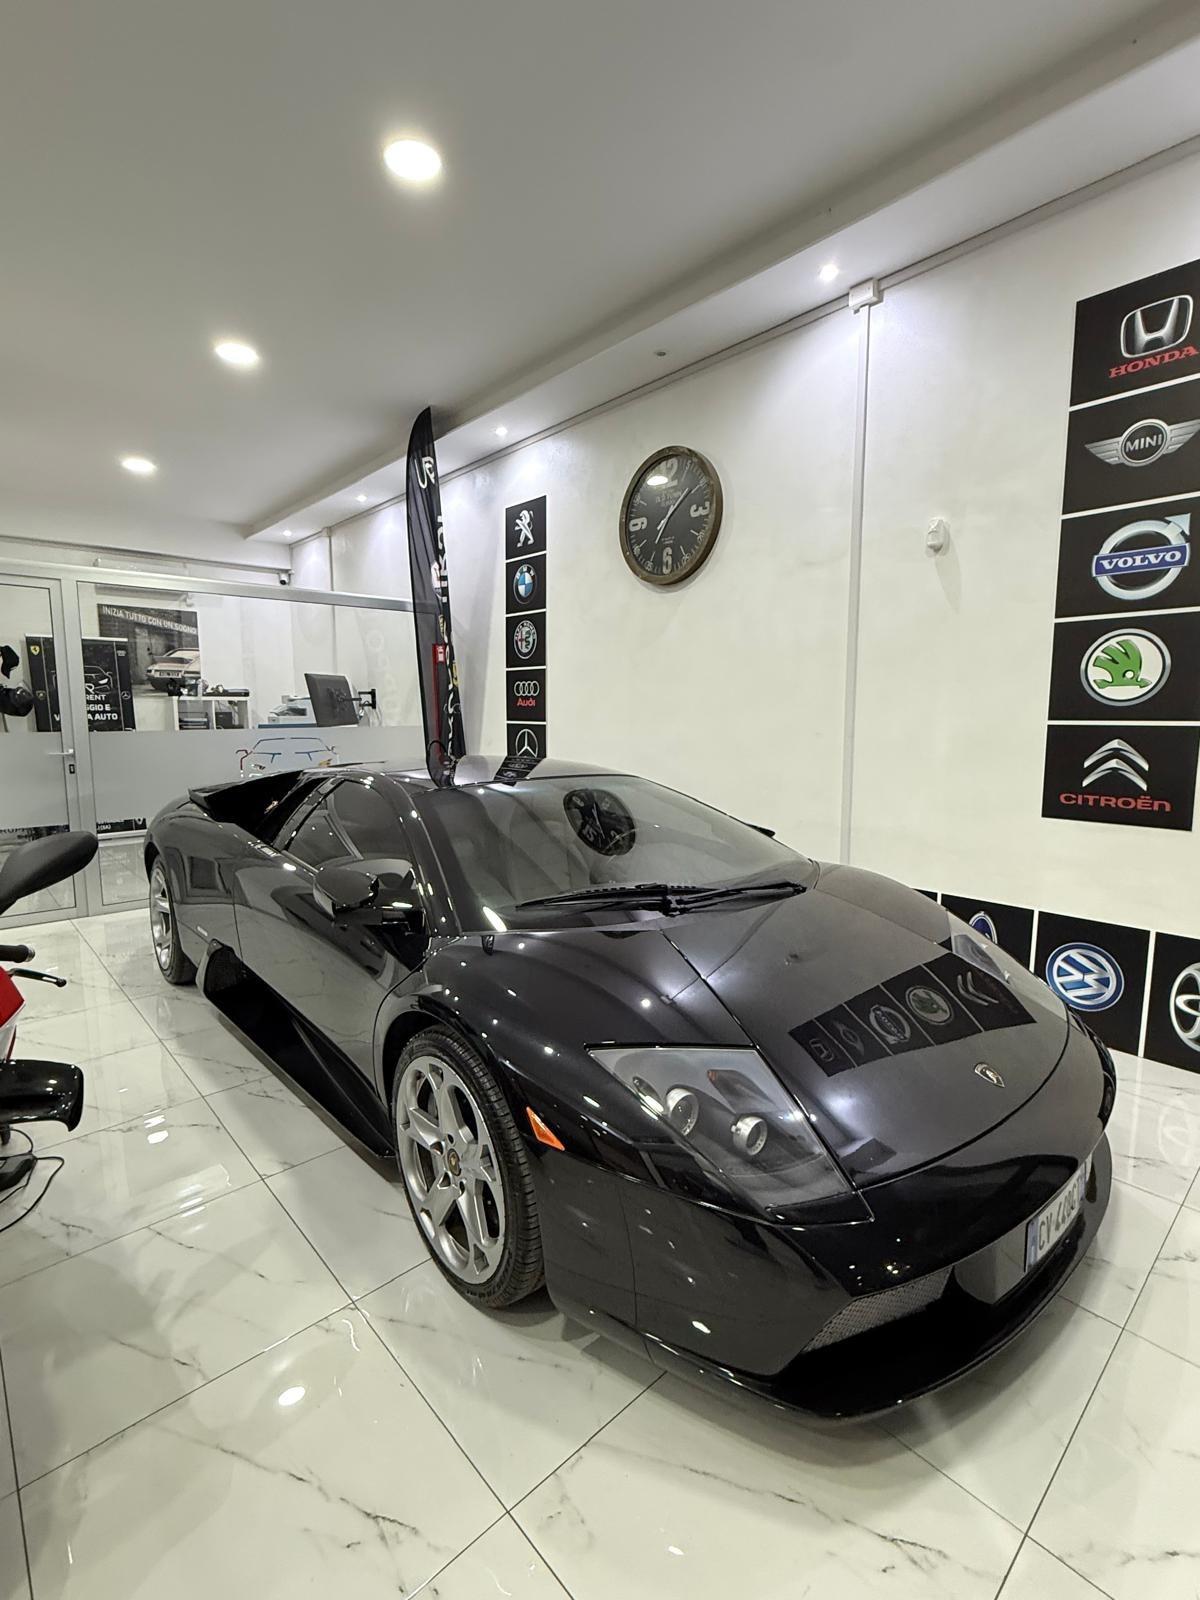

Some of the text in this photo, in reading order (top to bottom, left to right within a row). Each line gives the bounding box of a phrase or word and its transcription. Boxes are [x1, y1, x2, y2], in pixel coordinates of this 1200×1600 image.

[1108, 346, 1199, 378] HONDA
[1125, 434, 1162, 453] MINI
[690, 501, 710, 518] 3
[662, 547, 673, 575] 6
[1100, 551, 1182, 570] VOLVO
[102, 605, 125, 618] INIZIA
[126, 611, 147, 624] TUTTO
[147, 617, 162, 627] CON
[516, 697, 536, 707] Audi
